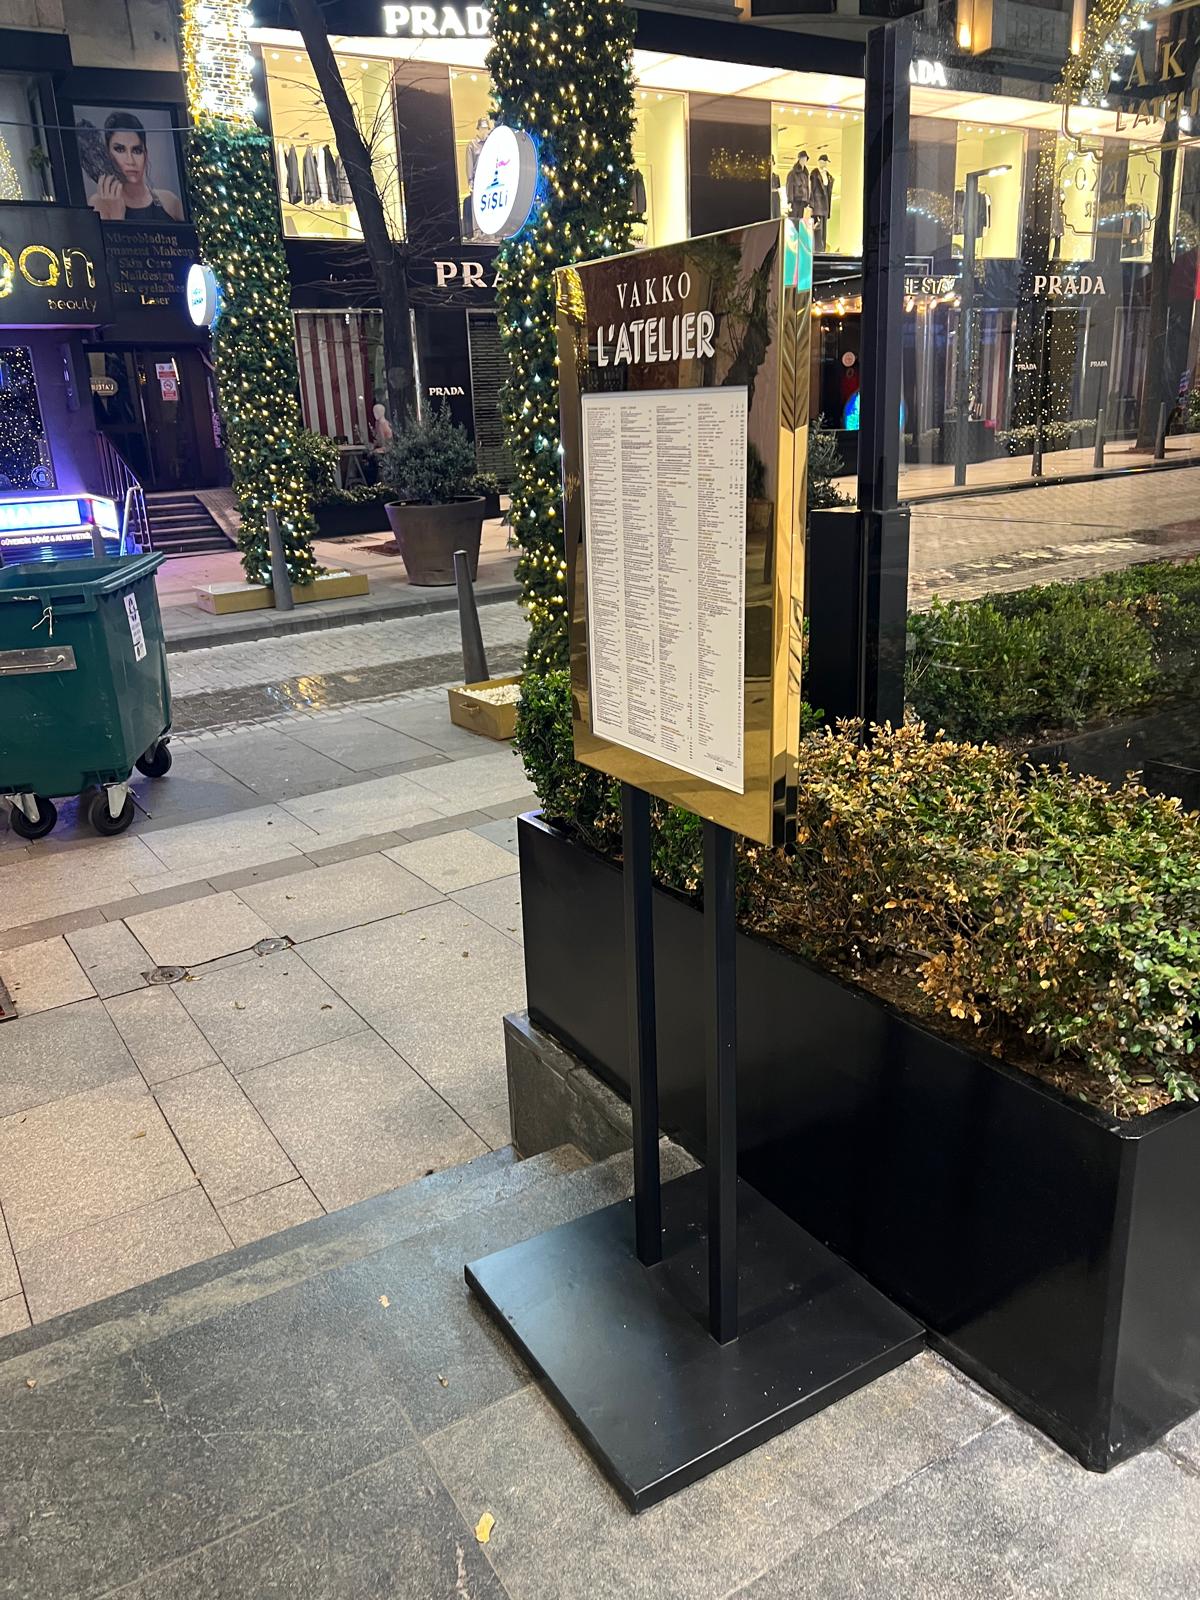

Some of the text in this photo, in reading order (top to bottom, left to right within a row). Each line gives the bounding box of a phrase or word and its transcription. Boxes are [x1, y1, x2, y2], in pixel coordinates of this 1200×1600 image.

[617, 272, 691, 309] VAKKO
[1033, 275, 1106, 295] PRADA
[48, 299, 97, 313] beauty
[597, 310, 716, 367] L'ATELIER
[428, 386, 465, 396] PRADA
